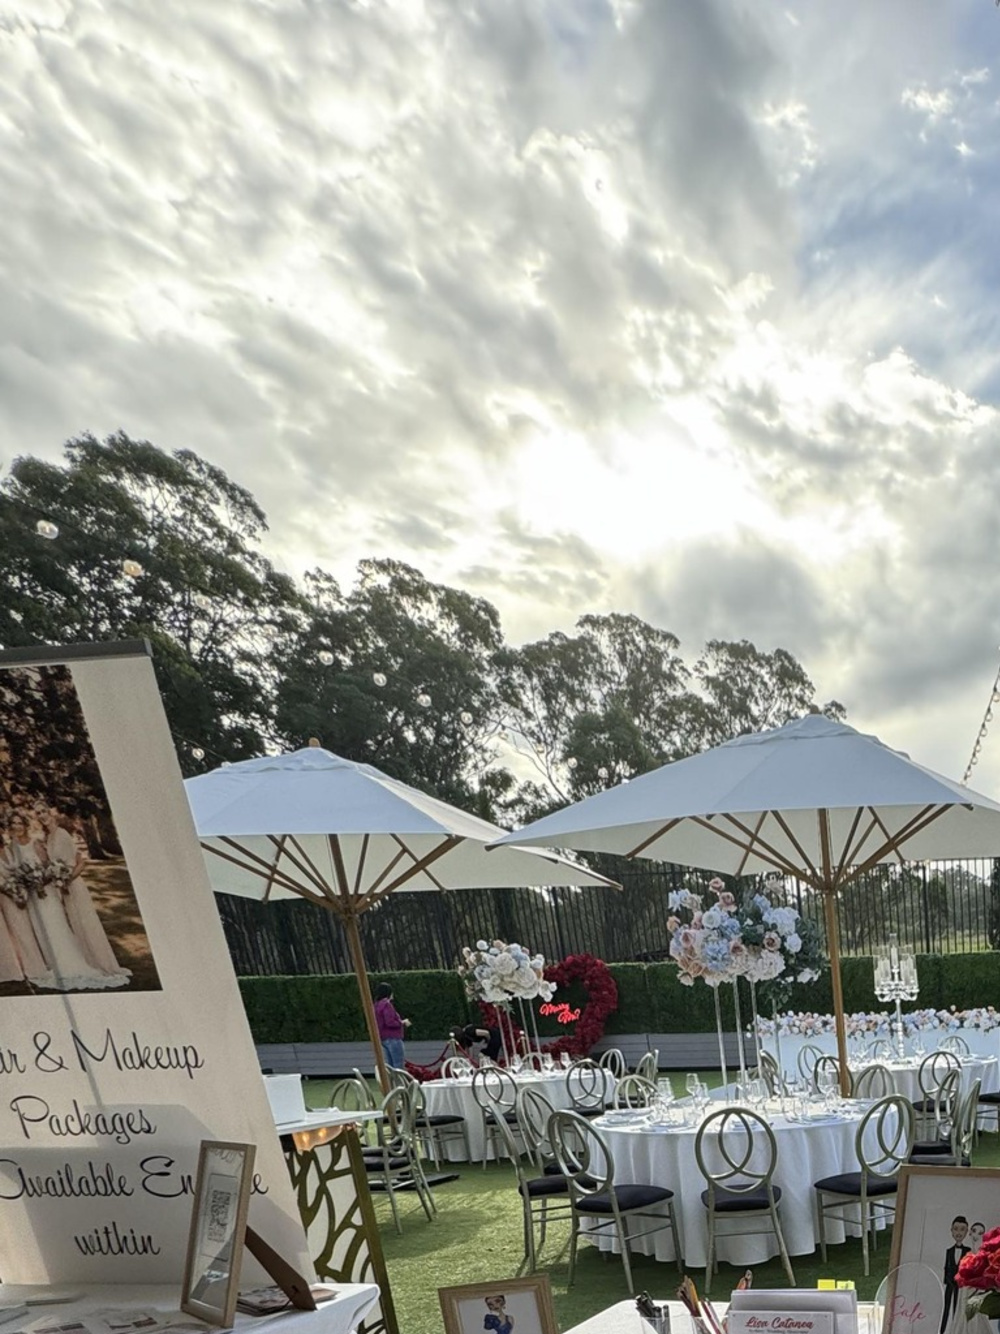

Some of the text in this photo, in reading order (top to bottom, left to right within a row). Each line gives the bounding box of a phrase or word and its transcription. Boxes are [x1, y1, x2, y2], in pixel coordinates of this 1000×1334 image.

[70, 1028, 205, 1080] Makeup
[9, 1095, 158, 1145] Packages
[0, 1158, 134, 1200] Available
[74, 1222, 161, 1256] within
